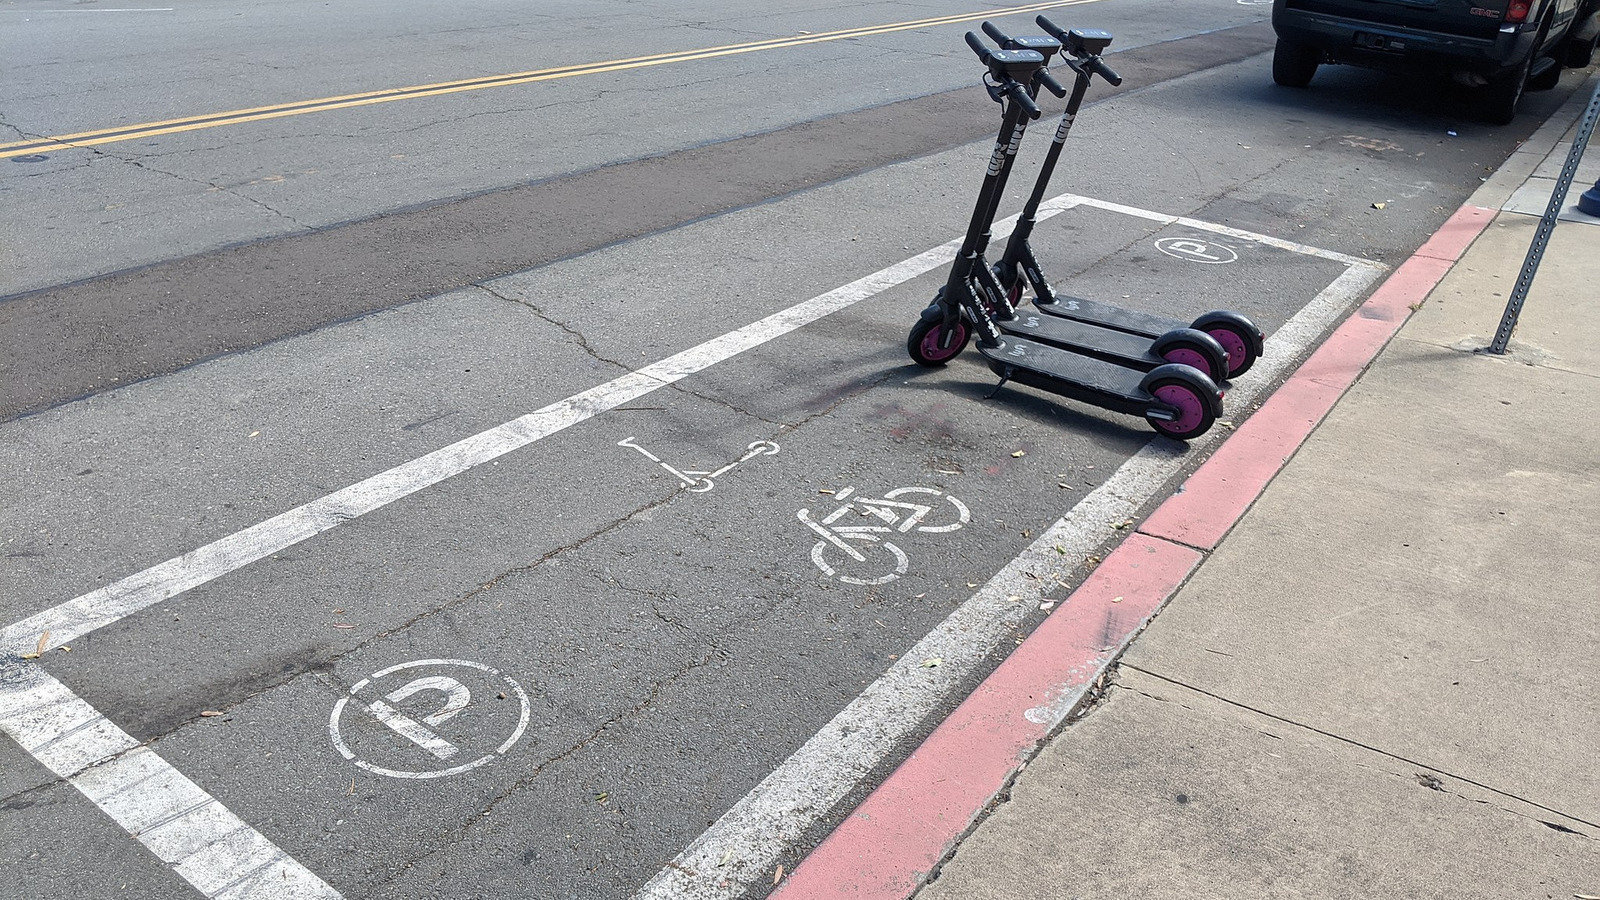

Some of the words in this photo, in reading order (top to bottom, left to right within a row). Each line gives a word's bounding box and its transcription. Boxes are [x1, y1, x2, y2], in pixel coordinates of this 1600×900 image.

[1470, 7, 1500, 19] GMC
[1167, 241, 1220, 260] P
[365, 675, 471, 760] P
